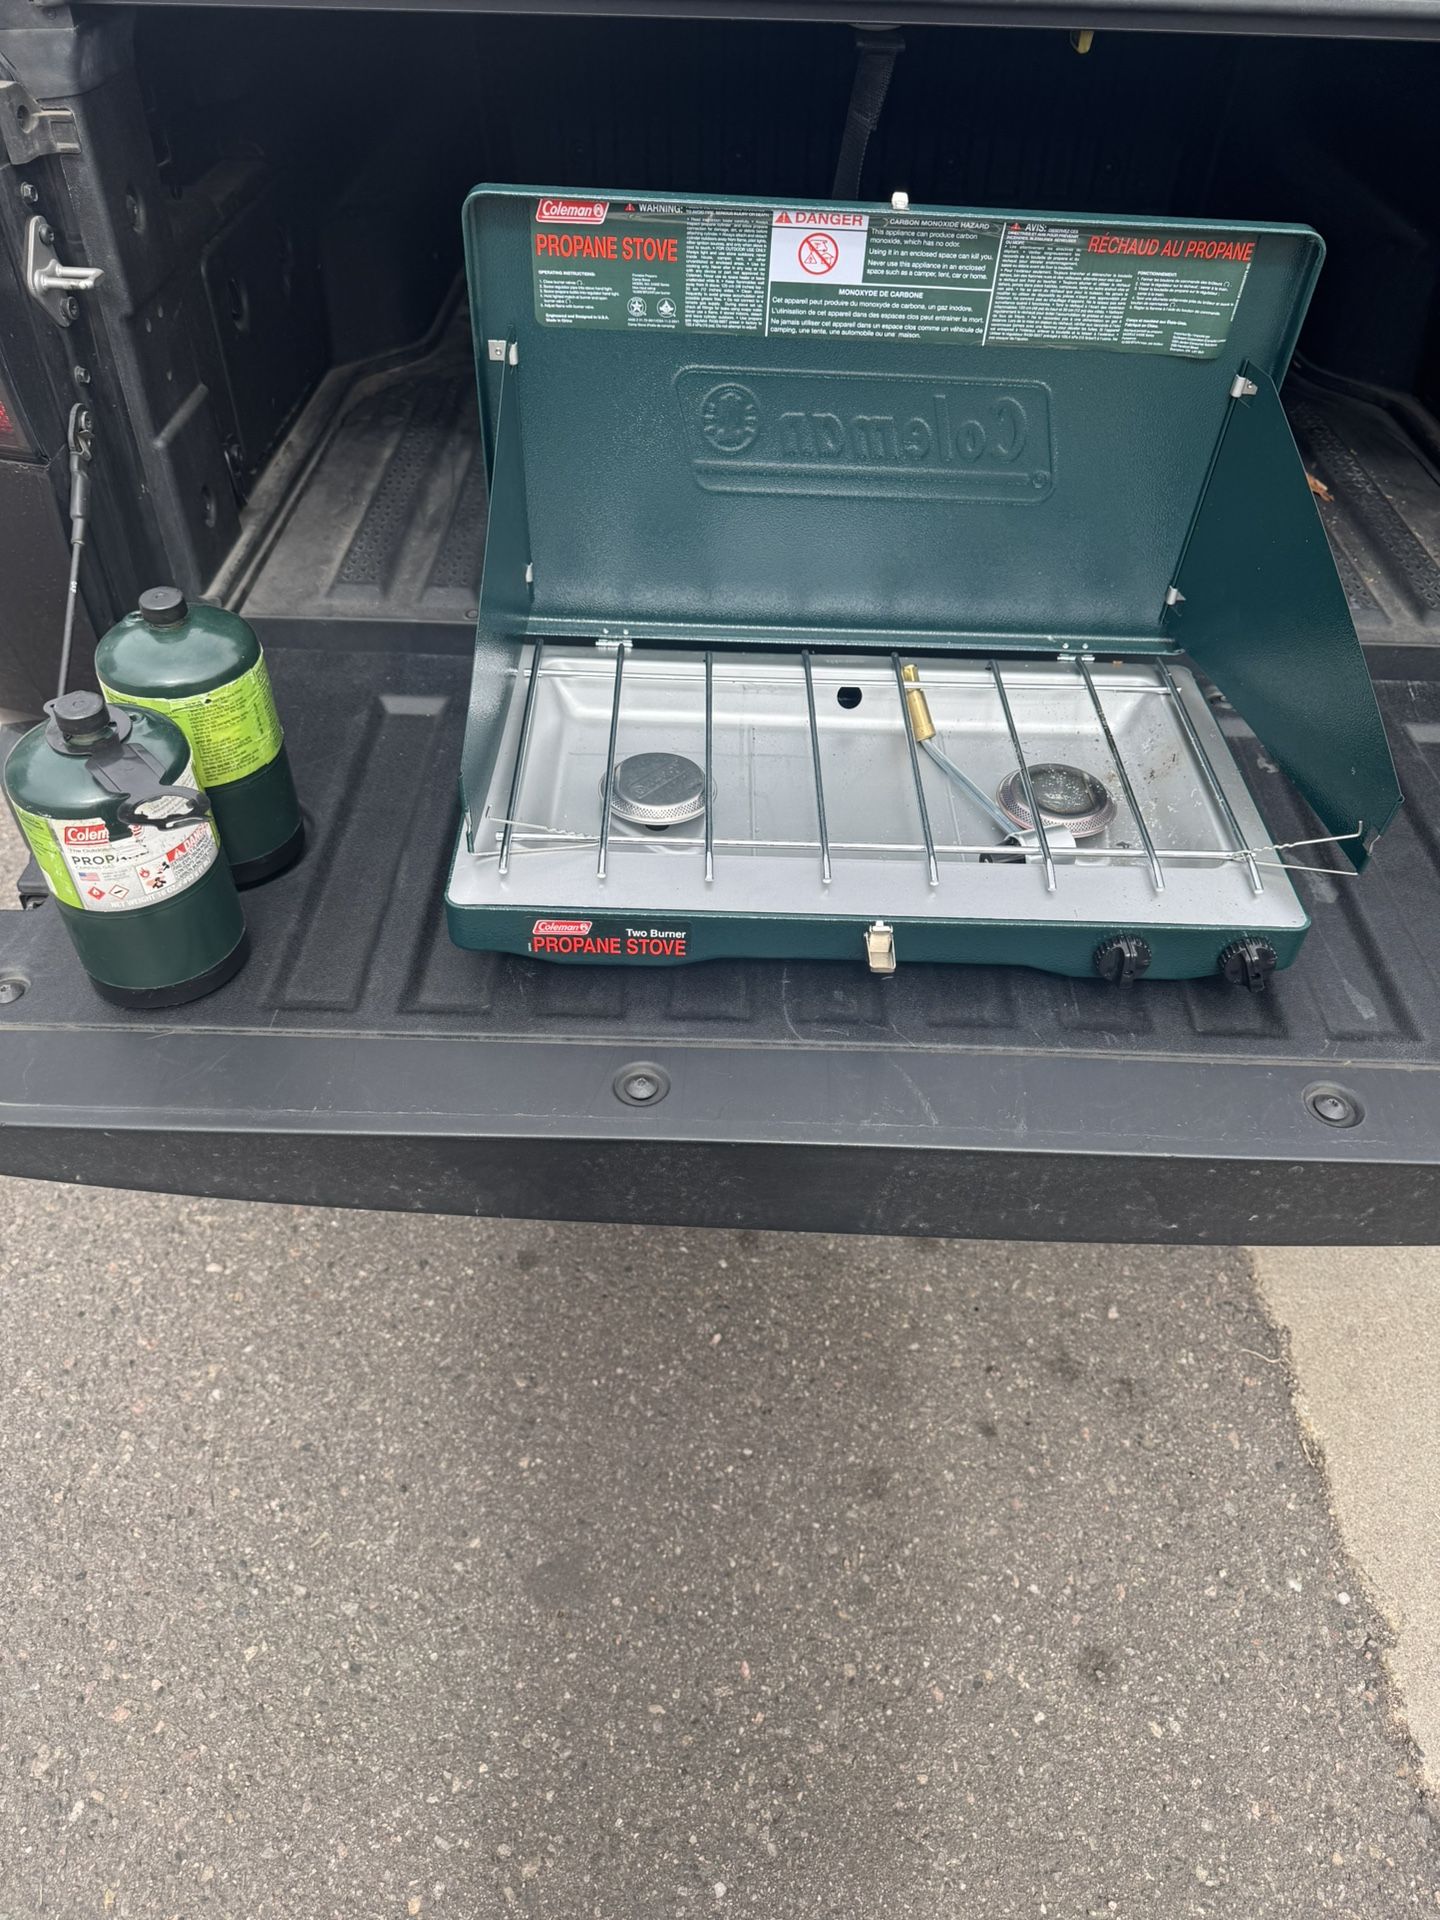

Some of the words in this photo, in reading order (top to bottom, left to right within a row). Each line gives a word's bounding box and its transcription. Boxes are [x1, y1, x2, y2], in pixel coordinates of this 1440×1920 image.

[542, 200, 592, 217] Coleman
[796, 212, 862, 226] DANGER
[886, 229, 915, 237] appliance
[1024, 223, 1047, 233] AVIS:
[870, 237, 902, 245] monoxide,
[1087, 232, 1160, 256] RÉCHAUD
[1160, 239, 1183, 258] AU
[1184, 239, 1256, 262] PROPANE
[536, 234, 618, 259] PROPANE
[621, 237, 678, 262] STOVE
[869, 248, 886, 256] Using
[910, 249, 937, 258] enclosed
[538, 922, 579, 931] Coleman
[626, 928, 646, 938] Two
[650, 930, 686, 940] Burner
[533, 936, 622, 954] PROPANE
[626, 938, 687, 956] STOVE
